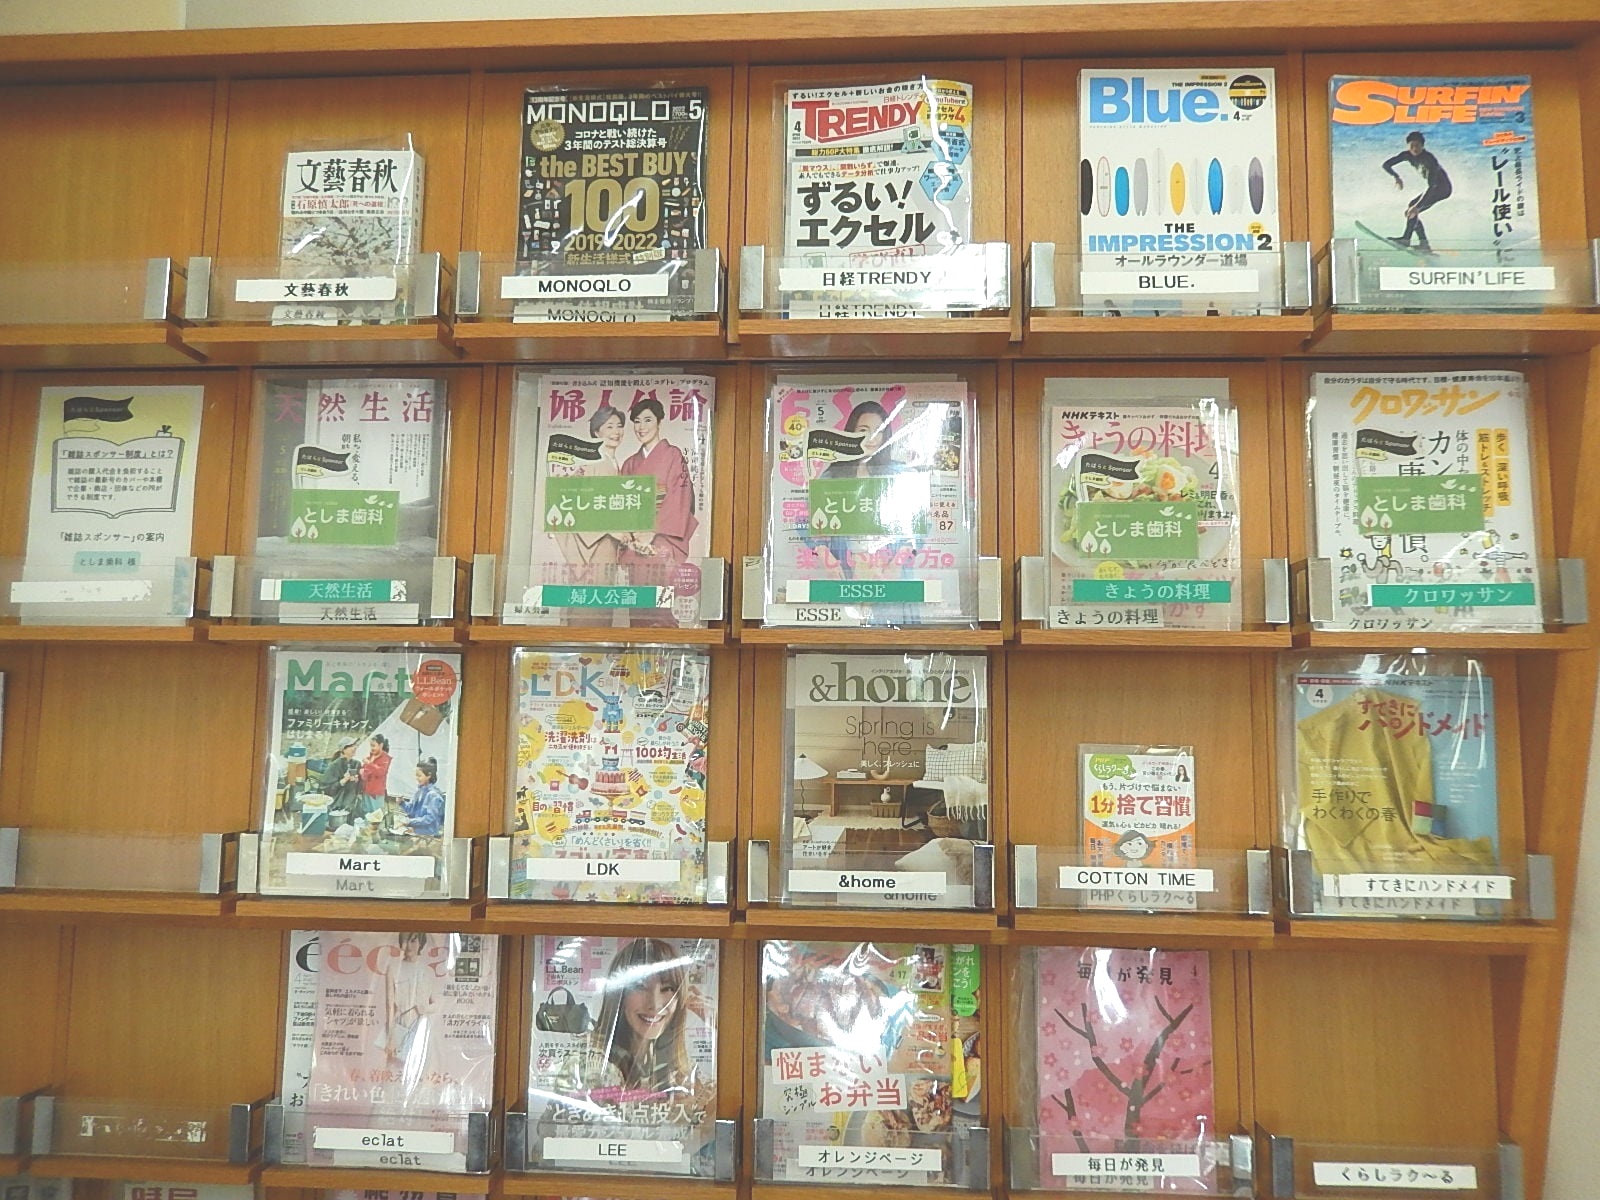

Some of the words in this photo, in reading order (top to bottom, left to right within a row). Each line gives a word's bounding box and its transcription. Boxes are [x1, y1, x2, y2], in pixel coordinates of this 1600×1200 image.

[1089, 77, 1229, 124] Blue.
[526, 100, 671, 125] MONOQLO
[688, 100, 702, 120] 5
[1393, 105, 1478, 123] LIFE
[792, 100, 924, 144] TRENDY
[575, 128, 657, 140] コロナと戦い続けた
[540, 154, 577, 178] the
[581, 153, 640, 177] BEST
[642, 151, 688, 177] BUY
[295, 157, 399, 194] 文藝春秋
[564, 176, 661, 233] 100
[797, 179, 913, 214] ずるい!
[797, 212, 936, 249] エクセル
[1165, 223, 1195, 233] THE
[1088, 234, 1254, 253] IMPRESSION
[1257, 234, 1273, 250] 2
[1115, 254, 1248, 267] オールラウンダー道場
[538, 279, 632, 293] MONOQLO
[823, 271, 932, 287] 日経TRENDY
[1138, 275, 1195, 289] BLUE.
[284, 283, 349, 297] 文藝春秋
[547, 308, 637, 323] MONOQLO
[272, 391, 434, 424] 天然生活
[1350, 384, 1500, 425] クロワッサン
[1061, 411, 1120, 420] NHKテキスト
[559, 494, 641, 511] としま歯科
[1373, 494, 1466, 511] としま歯科
[304, 507, 384, 525] としま歯科
[938, 520, 954, 531] 87
[1094, 521, 1182, 538] としま歯科
[60, 532, 165, 543] 「雑誌スポンサー」の案内
[80, 558, 123, 566] としま歯科
[308, 583, 373, 599] 天然生活
[570, 588, 638, 606] 婦人公論
[839, 584, 886, 598] ESSE
[1105, 583, 1211, 600] きょうの料理
[1404, 587, 1513, 604] クロワッサン
[321, 606, 377, 620] 天然生活
[795, 608, 842, 622] ESSE
[1057, 608, 1159, 625] きょうの料理
[1349, 616, 1432, 630] クロワッサン
[287, 659, 414, 698] Mart
[531, 665, 608, 698] LDK
[809, 661, 972, 704] &home
[1315, 689, 1325, 699] 4
[845, 715, 915, 740] Spring
[1312, 807, 1399, 822] わくわくの春
[339, 858, 381, 872] Mart
[586, 862, 620, 876] LDK
[335, 879, 375, 892] Mart
[838, 874, 896, 889] &home
[1077, 871, 1149, 885] COTTON
[1158, 873, 1197, 886] TIME
[1366, 878, 1496, 893] すてきにハンドメイド
[1076, 961, 1173, 985] 毎が発見
[776, 1051, 883, 1081] 悩まい
[819, 1077, 902, 1108] お弁当
[783, 1099, 817, 1115] シンプル
[361, 1133, 405, 1148] eclat
[598, 1143, 628, 1157] LEE
[818, 1150, 924, 1166] オレンジページ
[379, 1153, 421, 1166] eclat
[1087, 1157, 1165, 1173] 毎日が発見
